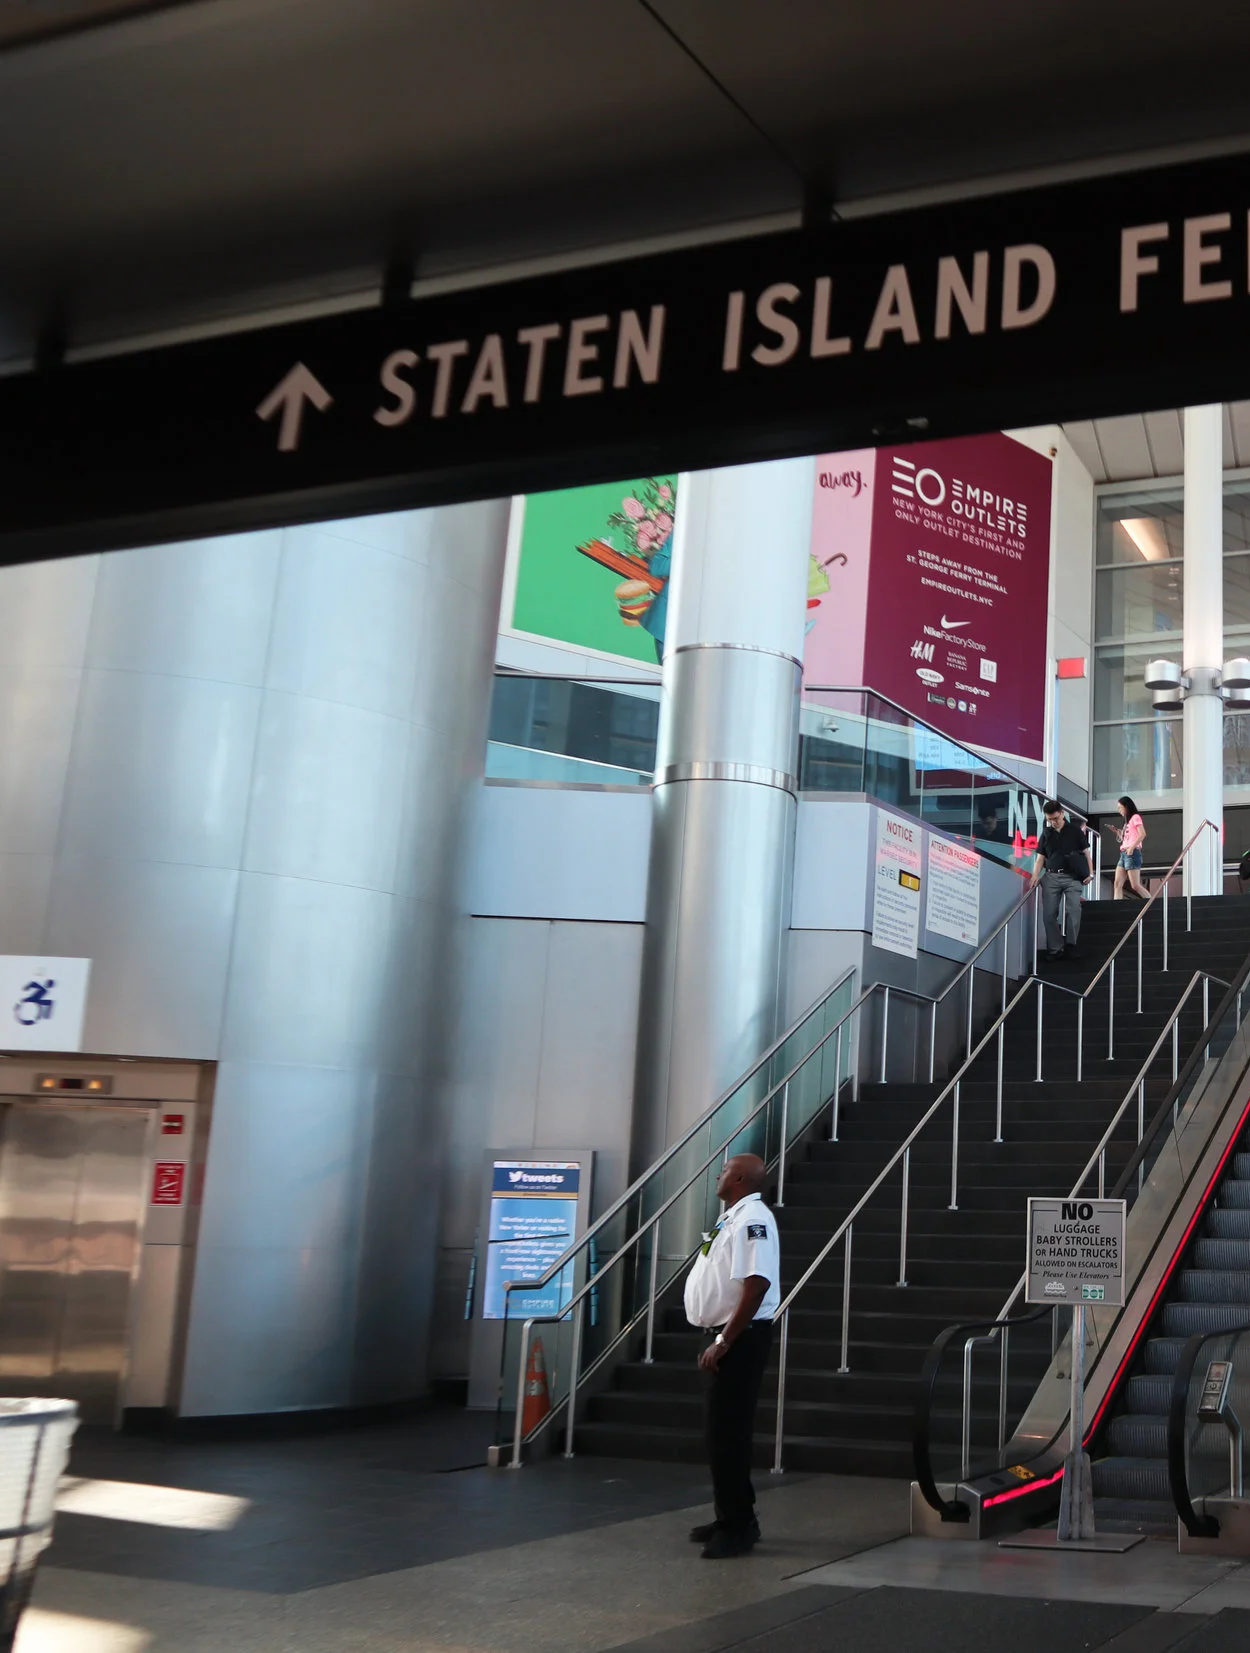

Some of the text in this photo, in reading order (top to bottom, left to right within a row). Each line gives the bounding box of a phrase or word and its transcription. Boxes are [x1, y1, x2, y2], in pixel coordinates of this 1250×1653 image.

[372, 304, 666, 428] STATEN
[722, 243, 1057, 372] ISLAND
[820, 470, 868, 498] away.
[952, 478, 1028, 522] EMPIRE
[892, 496, 1025, 551] NEW YORK CITY'S FIRST AND
[952, 500, 1026, 538] OUTLETS
[894, 509, 1022, 560] ONLY OUTLET DESTINATION
[906, 554, 1008, 594] ST. GEORGE FERRY TERMINAL
[918, 549, 998, 582] STEPS AWAY FROM THE
[920, 576, 994, 606] EMPIREOUTLETS.NYC
[910, 640, 935, 663] H&M
[886, 820, 913, 842] NOTICE
[930, 840, 954, 858] ATTENTION
[878, 864, 896, 880] LEVEL
[522, 1173, 564, 1183] tweets
[1062, 1202, 1094, 1220] NO
[1054, 1224, 1100, 1234] LUGGAGE
[1036, 1235, 1117, 1246] BABY STROLLERS
[1049, 1248, 1078, 1257] HAND
[1080, 1248, 1118, 1258] TRUCKS
[1079, 1272, 1110, 1280] Elevators
[1082, 1289, 1104, 1298] DOT
